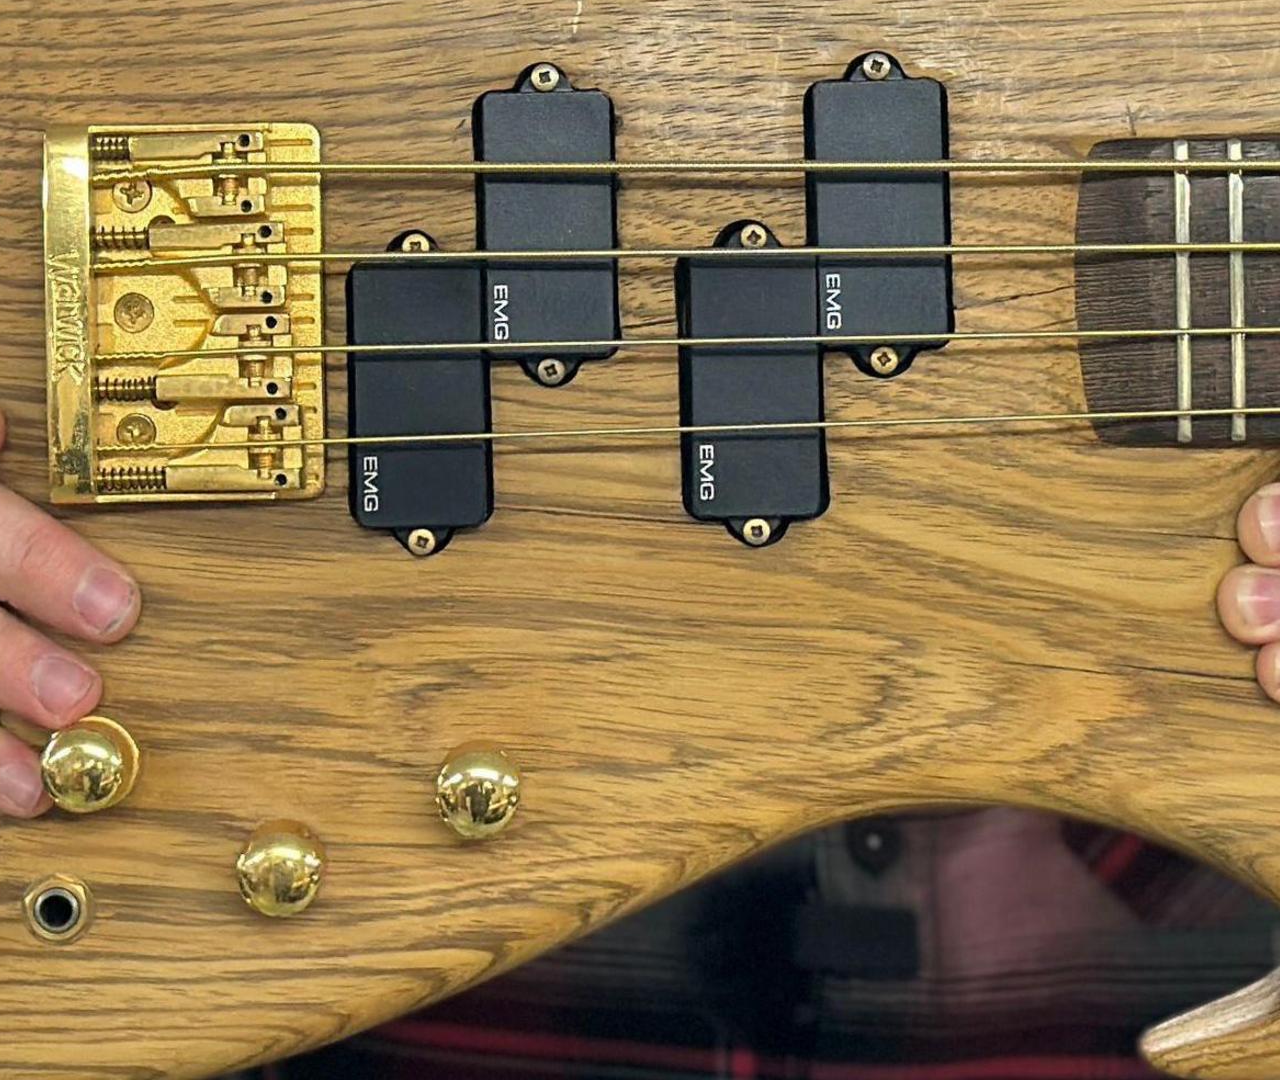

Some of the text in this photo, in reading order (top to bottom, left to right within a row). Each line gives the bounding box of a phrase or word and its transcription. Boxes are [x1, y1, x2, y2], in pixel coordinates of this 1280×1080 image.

[493, 284, 510, 341] EMG
[825, 273, 843, 330] EMG
[363, 456, 379, 512] EMG
[699, 444, 715, 501] EMG
